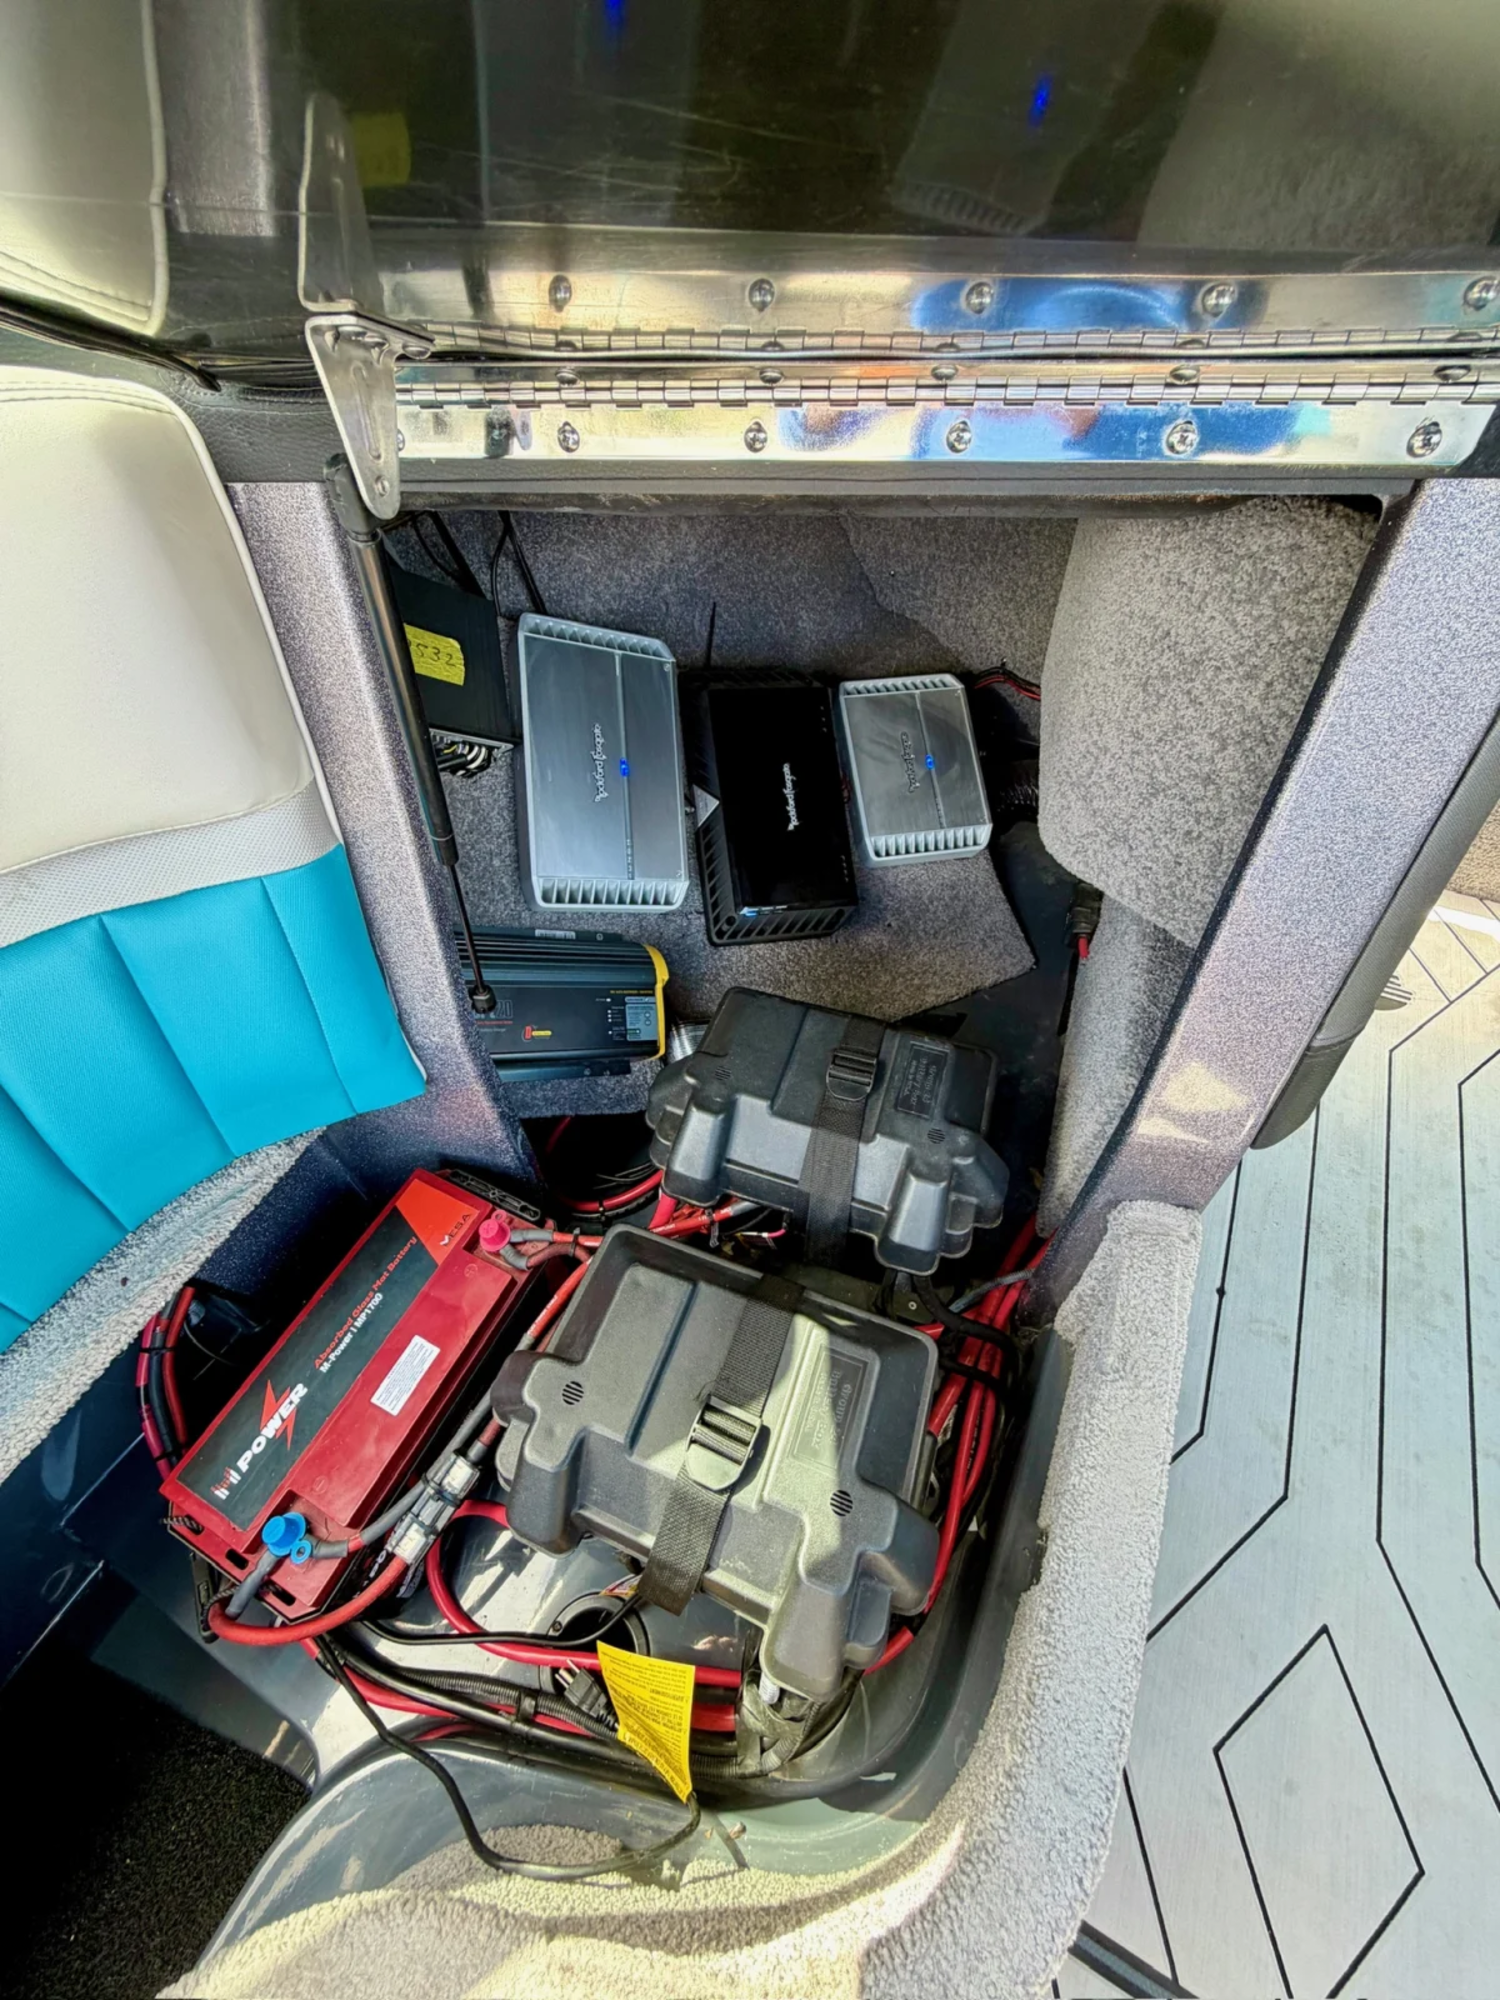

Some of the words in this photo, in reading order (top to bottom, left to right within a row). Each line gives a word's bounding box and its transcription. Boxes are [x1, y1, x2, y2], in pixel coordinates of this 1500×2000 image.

[408, 641, 456, 667] 532
[590, 723, 607, 761] Fosgate
[592, 762, 609, 802] Rockford
[782, 763, 797, 795] Fosgate
[786, 795, 800, 831] Rockford
[315, 1317, 354, 1369] Absorbed
[352, 1290, 375, 1318] Glass
[372, 1271, 390, 1291] Mat
[386, 1236, 417, 1272] Battery
[320, 1333, 353, 1373] M-Power
[354, 1292, 383, 1328] MP1700
[238, 1384, 307, 1473] POWER
